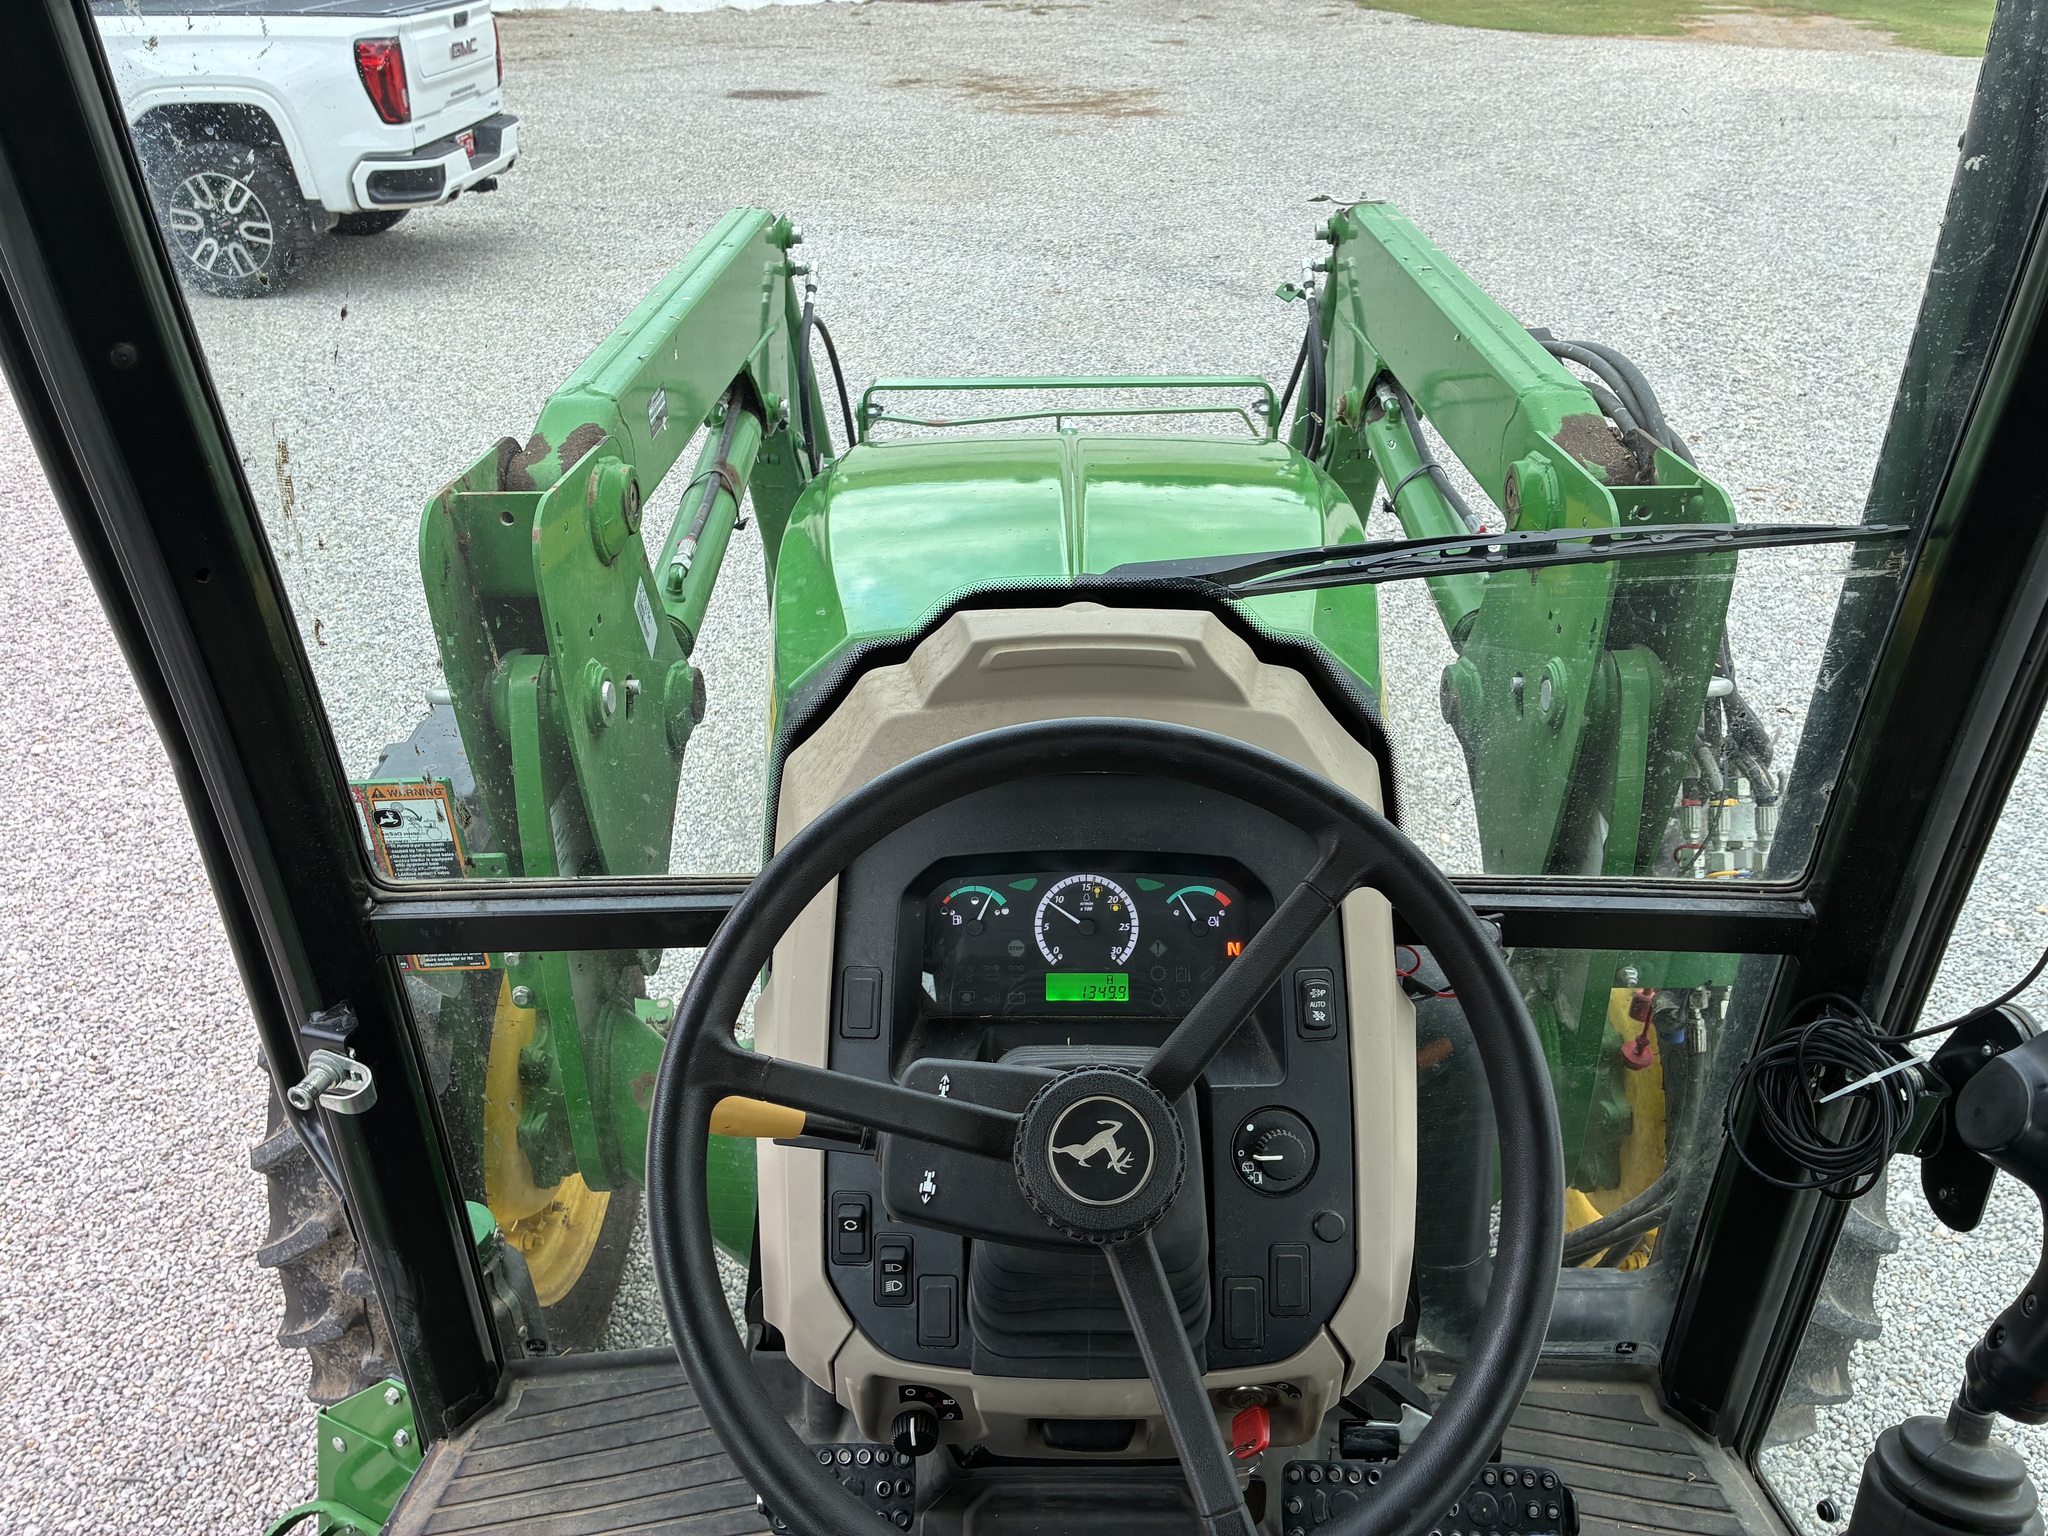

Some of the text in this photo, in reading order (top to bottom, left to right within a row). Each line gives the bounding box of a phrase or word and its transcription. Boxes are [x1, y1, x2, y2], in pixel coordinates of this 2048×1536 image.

[451, 37, 478, 59] GMC
[1082, 883, 1091, 891] 15
[1055, 895, 1064, 903] 10
[1107, 895, 1119, 904] 20
[1043, 923, 1050, 931] 5
[1118, 923, 1130, 931] 25
[1053, 946, 1059, 954] 0
[1111, 946, 1122, 955] 30
[1227, 941, 1241, 956] N
[1082, 985, 1127, 1000] 1349.9
[1309, 1000, 1326, 1008] AUTO
